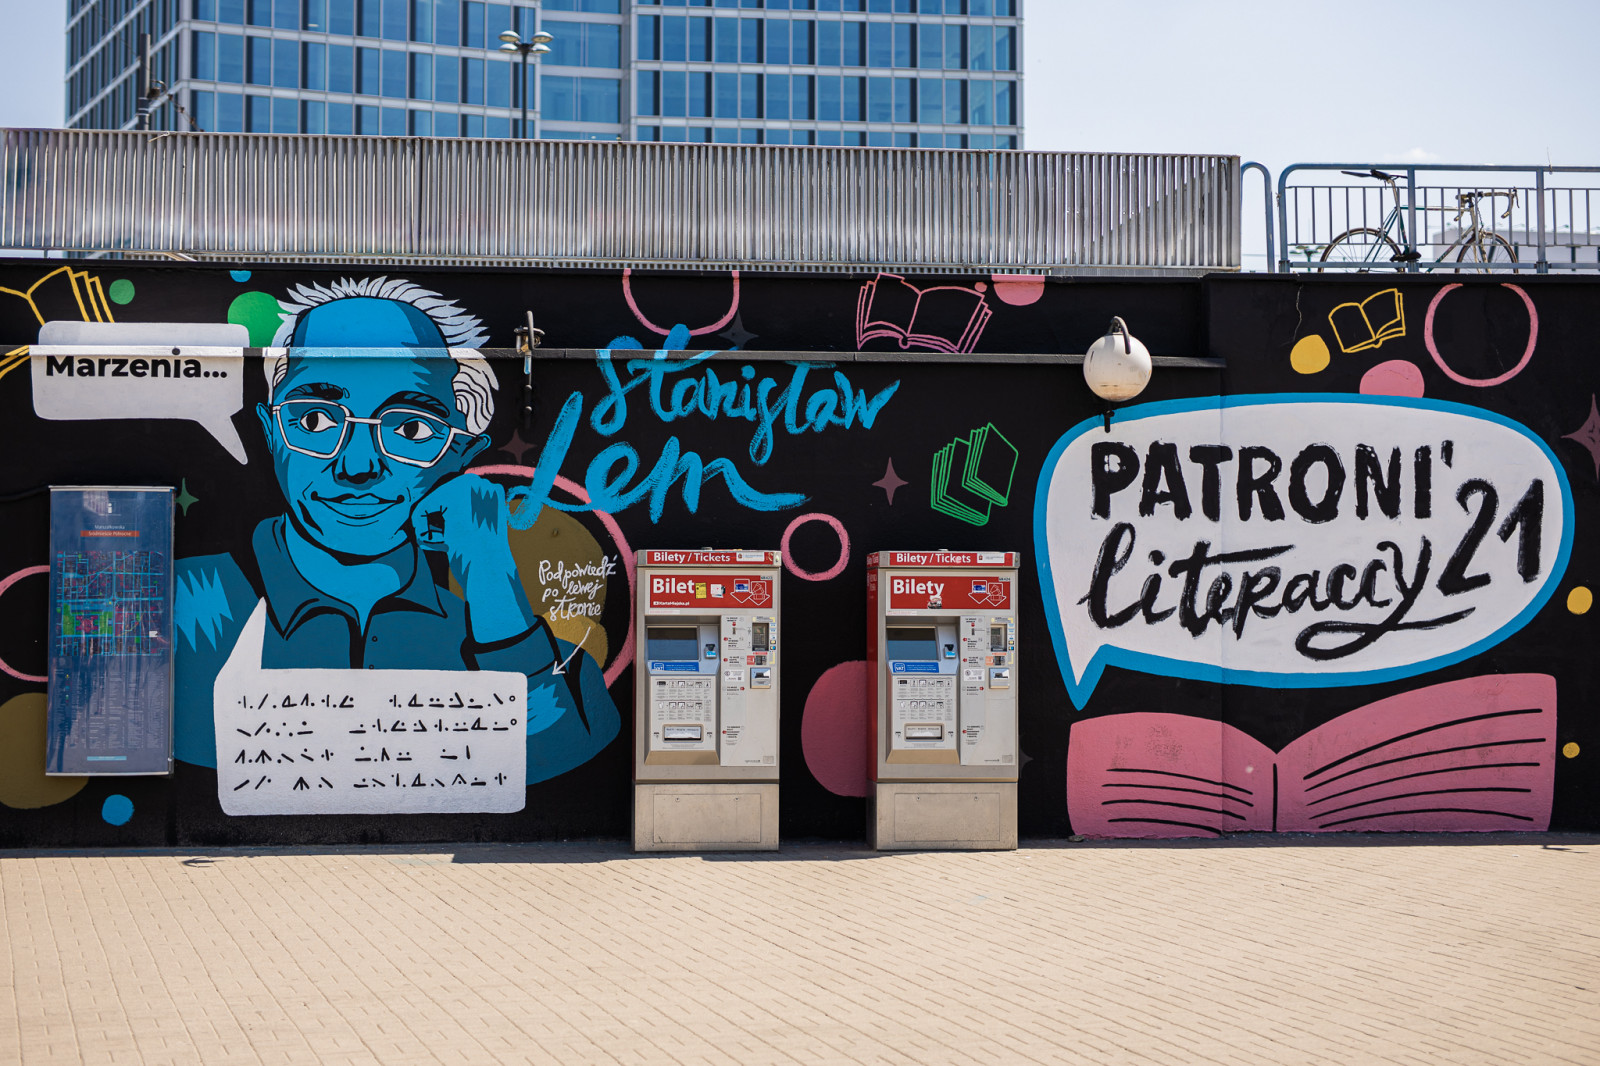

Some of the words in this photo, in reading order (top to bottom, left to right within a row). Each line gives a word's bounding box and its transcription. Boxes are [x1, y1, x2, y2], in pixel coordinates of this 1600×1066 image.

[46, 349, 228, 378] Marzenia...
[506, 391, 812, 530] Lem
[653, 552, 686, 564] Bilety
[693, 552, 731, 562] Tickets
[896, 553, 927, 565] Bilety
[935, 553, 971, 564] Tickets
[541, 588, 559, 602] po
[566, 579, 604, 600] lewej
[893, 578, 945, 598] Bilety
